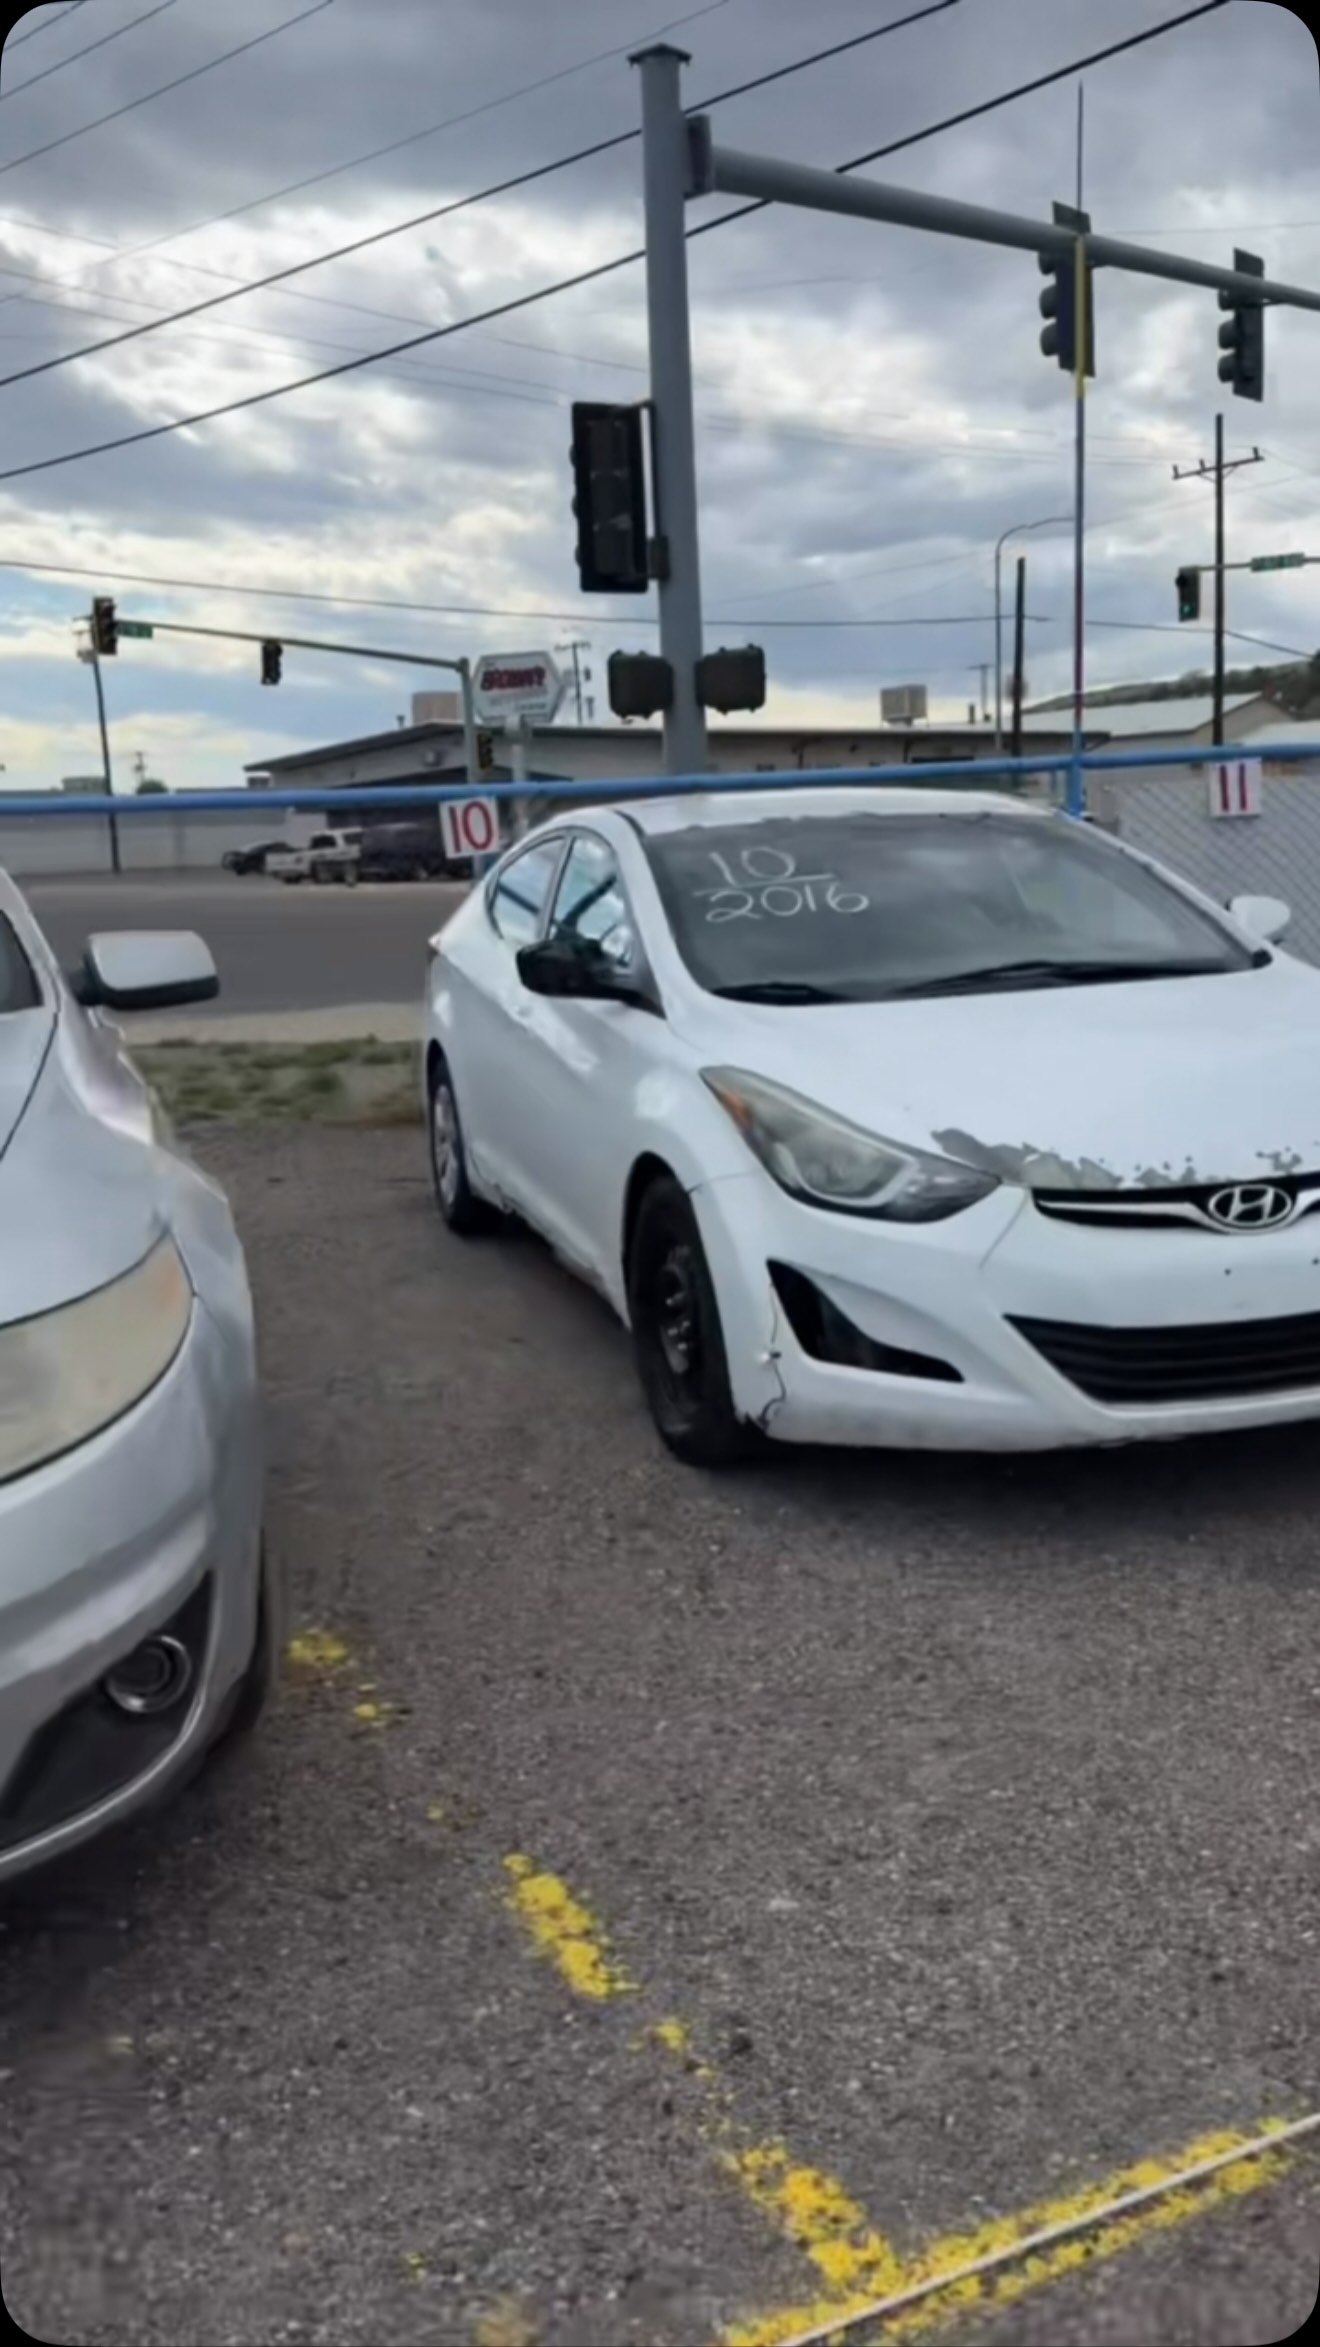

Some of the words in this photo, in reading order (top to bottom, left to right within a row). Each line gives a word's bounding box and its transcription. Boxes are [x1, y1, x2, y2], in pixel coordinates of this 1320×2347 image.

[1219, 763, 1247, 811] 11
[448, 801, 493, 853] 10
[709, 846, 795, 887] 10
[706, 882, 869, 923] 2016
